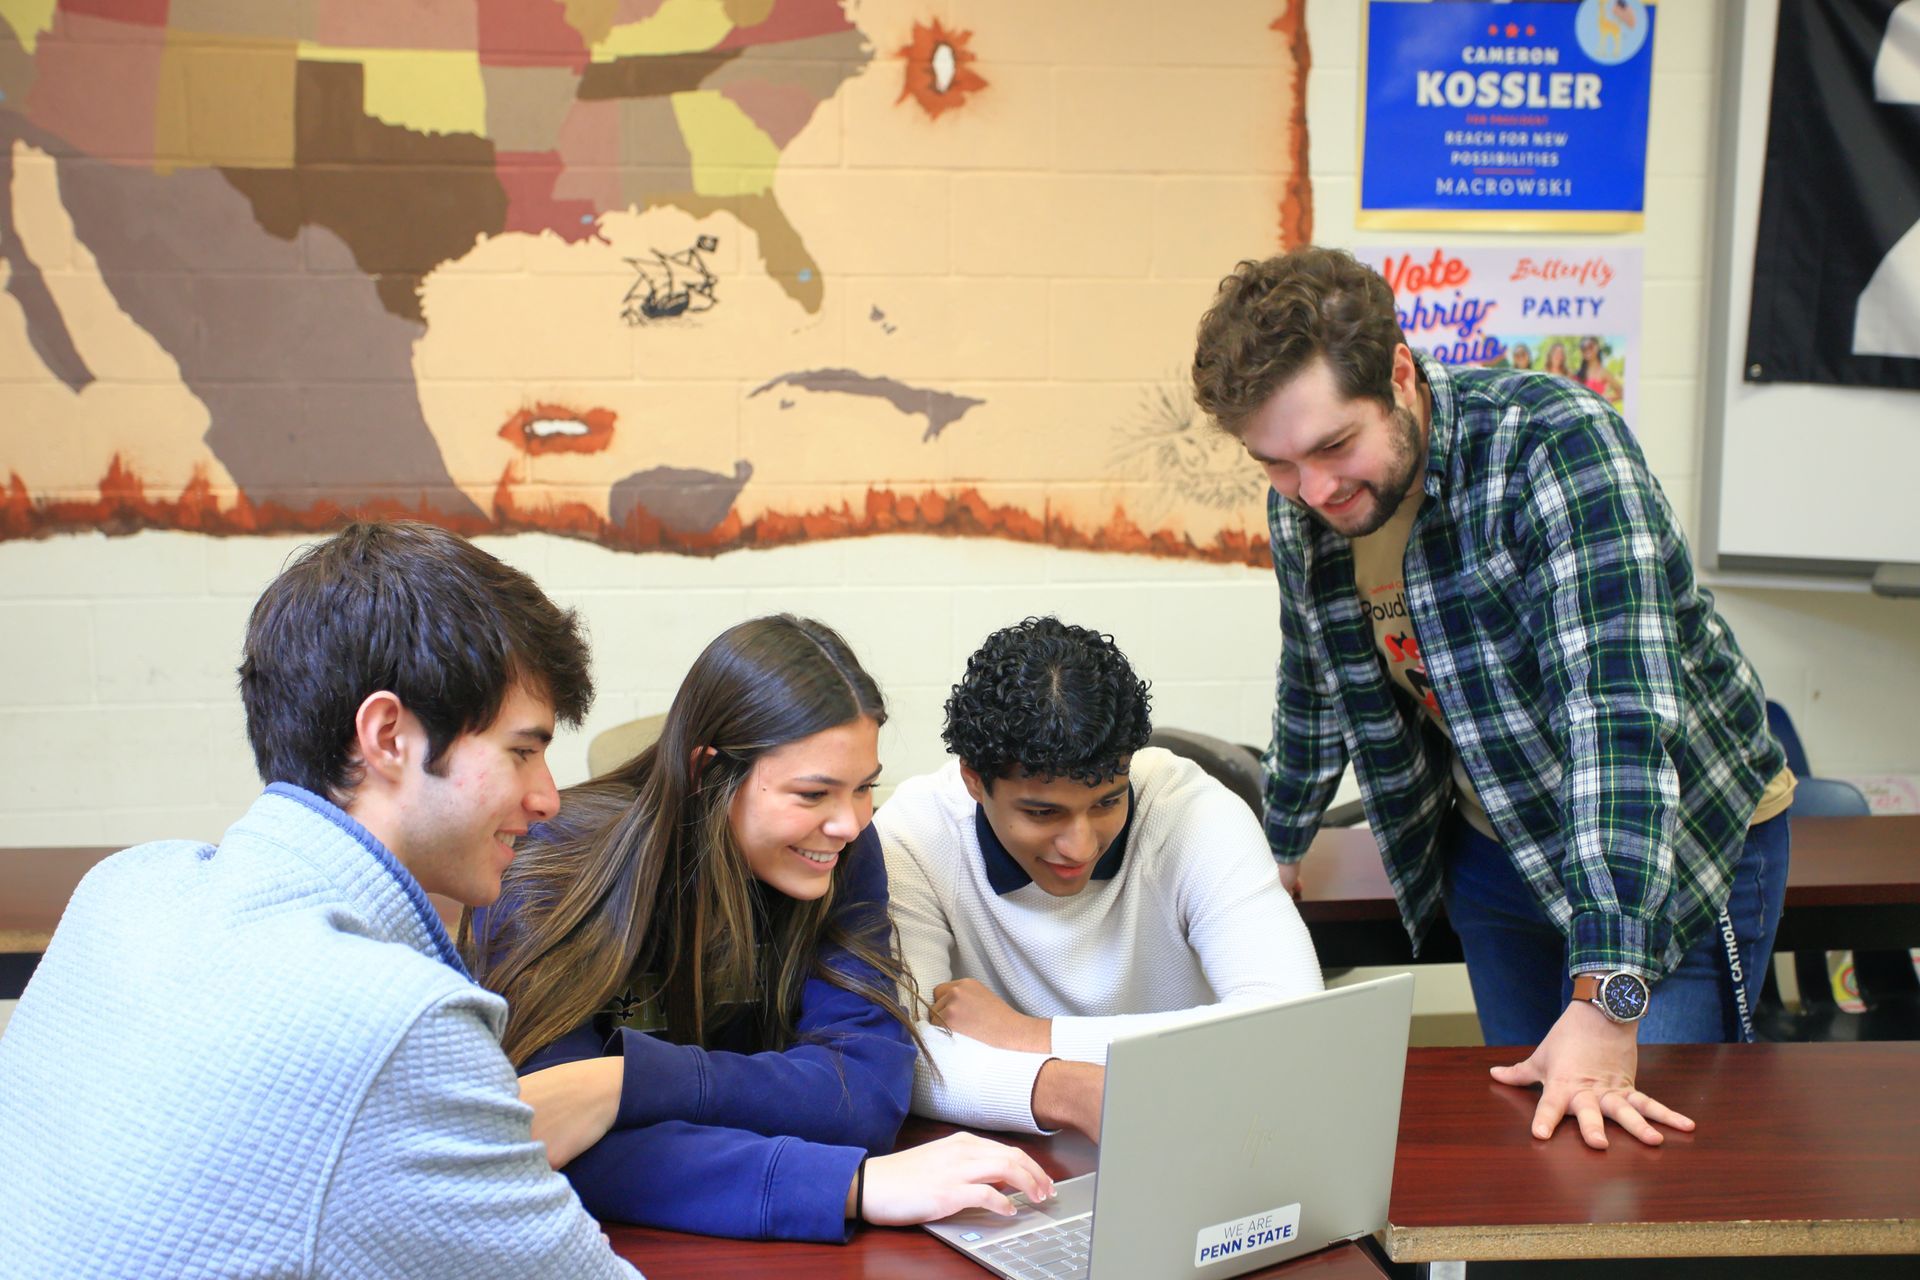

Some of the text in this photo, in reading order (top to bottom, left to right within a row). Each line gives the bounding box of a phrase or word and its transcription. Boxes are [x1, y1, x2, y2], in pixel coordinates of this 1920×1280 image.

[1461, 46, 1559, 65] CAMERON
[1415, 70, 1603, 109] KOSSLER
[1444, 131, 1569, 147] REACH FOR NEW
[1450, 151, 1560, 167] POSSIBILITIES
[1436, 177, 1572, 197] MACROWSKI
[1383, 248, 1471, 294] Vote
[1521, 296, 1606, 318] PARTY
[1224, 1215, 1273, 1239] WE ARE
[1200, 1238, 1242, 1262] PENN
